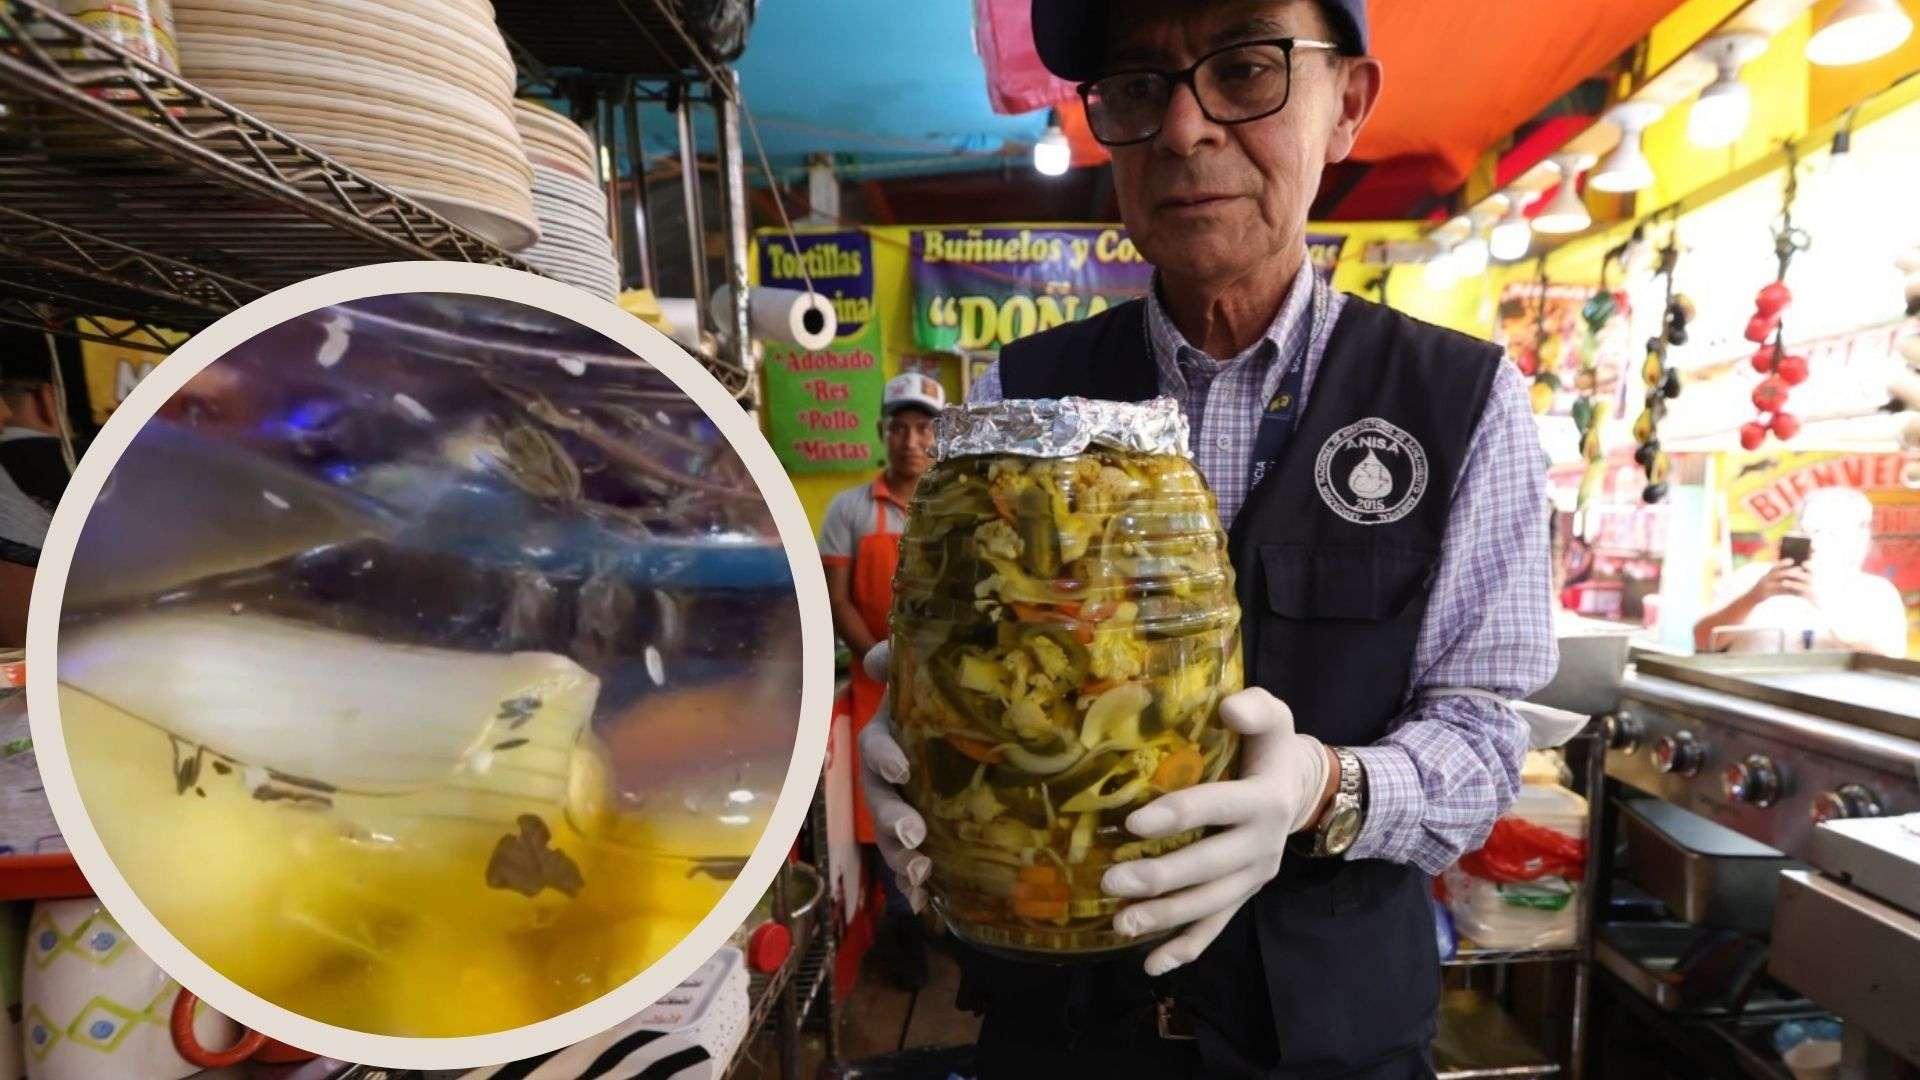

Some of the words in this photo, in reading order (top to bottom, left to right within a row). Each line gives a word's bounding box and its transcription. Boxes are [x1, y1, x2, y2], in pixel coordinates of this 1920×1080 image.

[767, 243, 862, 279] Tortillas
[923, 227, 1061, 263] Buñuelos
[1066, 238, 1089, 271] y
[1096, 230, 1144, 263] Co
[833, 290, 869, 323] ina
[809, 409, 859, 431] Pollo
[1345, 436, 1401, 454] ANISA
[1356, 499, 1386, 511] 2015
